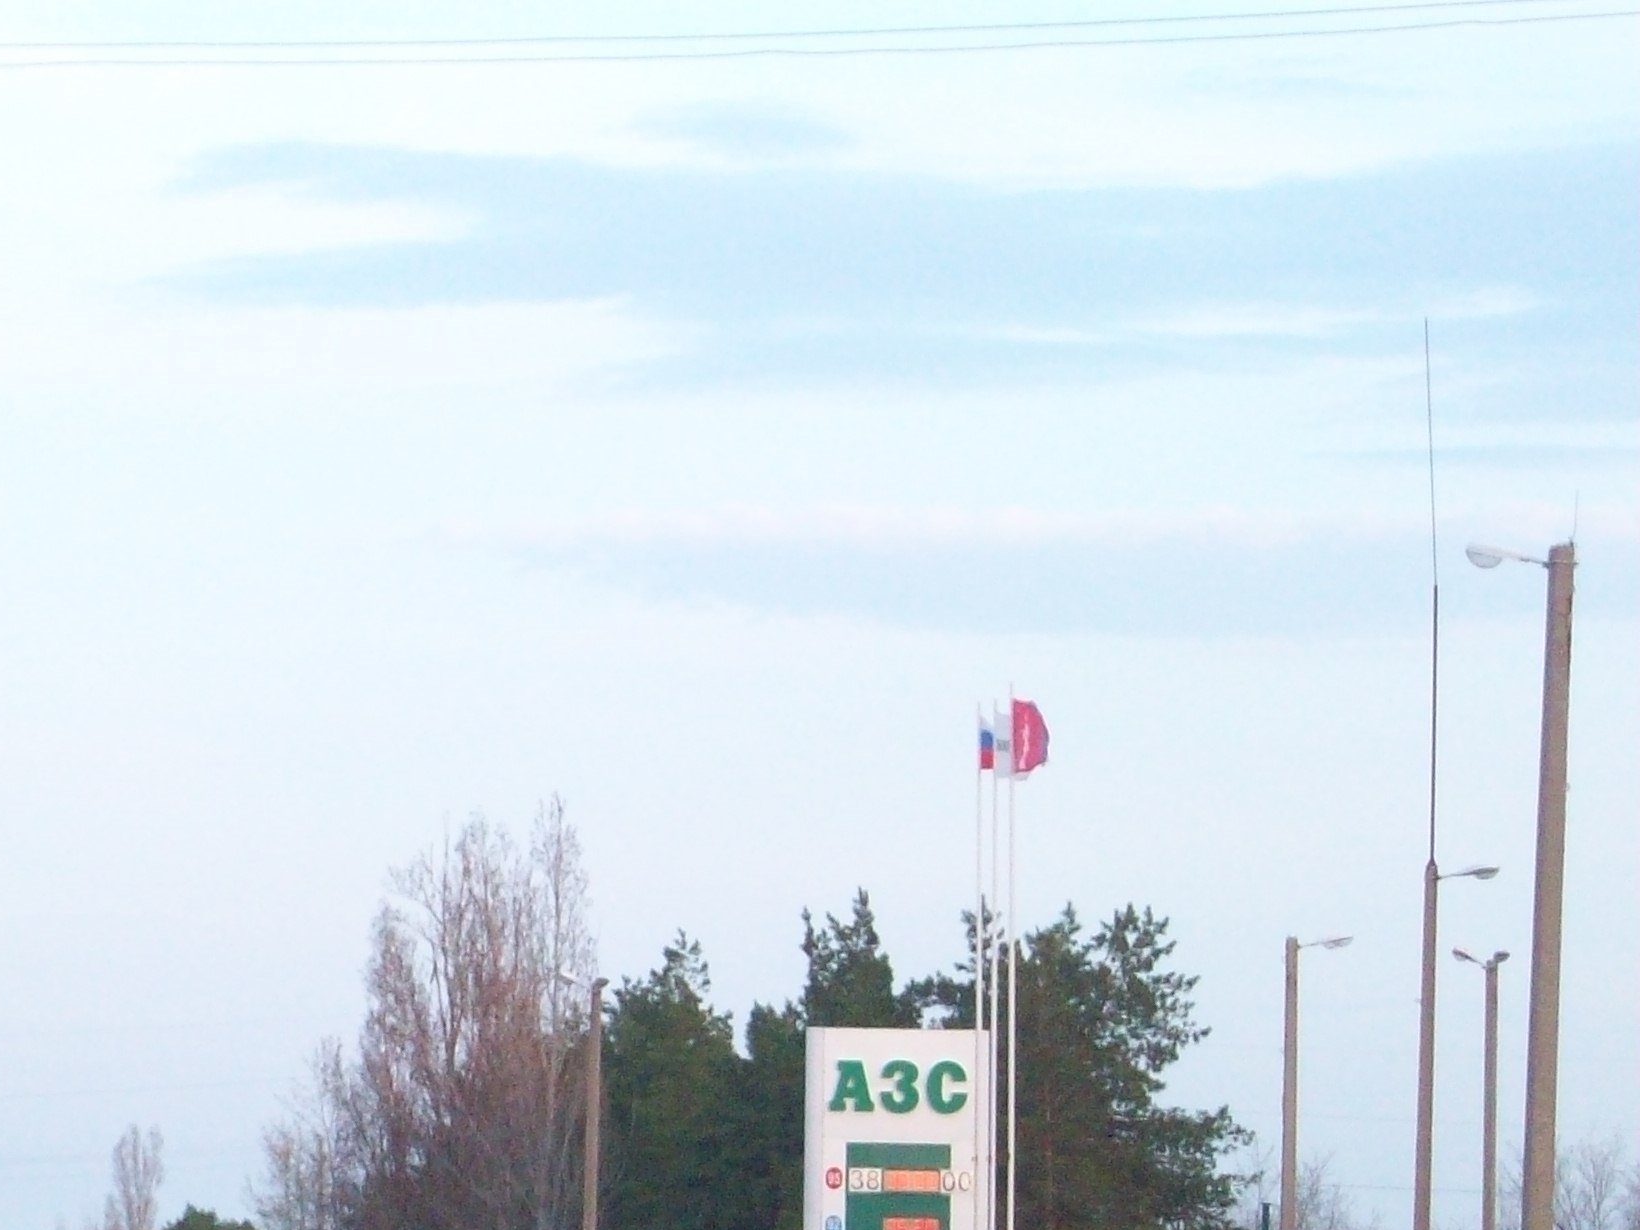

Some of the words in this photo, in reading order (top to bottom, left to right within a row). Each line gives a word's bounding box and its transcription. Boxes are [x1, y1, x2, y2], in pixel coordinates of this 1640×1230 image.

[828, 1060, 968, 1114] АЗС
[850, 1170, 879, 1190] 38
[942, 1172, 971, 1191] 00
